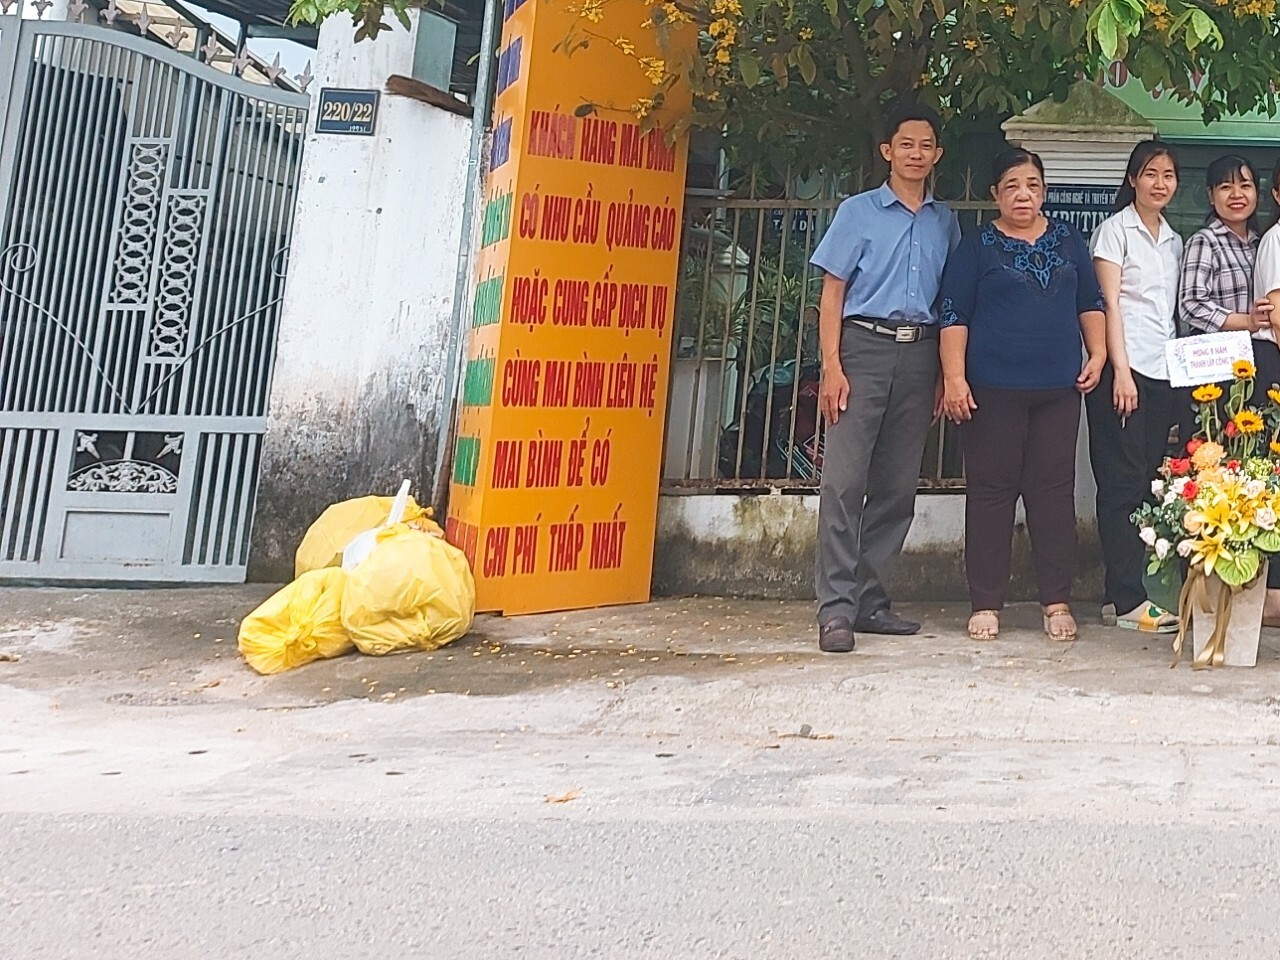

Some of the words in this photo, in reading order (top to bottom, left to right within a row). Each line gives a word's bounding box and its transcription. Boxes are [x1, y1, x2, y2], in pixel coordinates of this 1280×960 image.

[322, 101, 373, 122] 220/22
[527, 104, 577, 160] KHÁCH
[580, 109, 617, 165] HÀNG
[619, 123, 645, 169] MAI
[518, 183, 540, 240] CÓ
[540, 195, 573, 242] NHU
[572, 182, 602, 245] CẦU
[605, 189, 651, 253] QUẢNG
[651, 196, 677, 252] CÁO
[510, 268, 549, 333] HOẶC
[552, 279, 590, 327] CUNG
[591, 264, 618, 327] CẤP
[618, 283, 648, 337] DỊCH
[651, 285, 668, 338] VỤ
[501, 349, 541, 408] CÙNG
[542, 361, 572, 408] MAI
[572, 351, 606, 408] BÌNH
[605, 352, 637, 408] LIÊN
[638, 353, 658, 417] HỆ
[491, 440, 523, 489] MAI
[525, 429, 563, 488] BÌNH
[566, 416, 590, 487] ĐỂ
[590, 428, 612, 487] CÓ
[483, 527, 510, 579] CHI
[512, 512, 542, 576] PHÍ
[548, 504, 584, 573] THẤP
[589, 502, 627, 570] NHẤT
